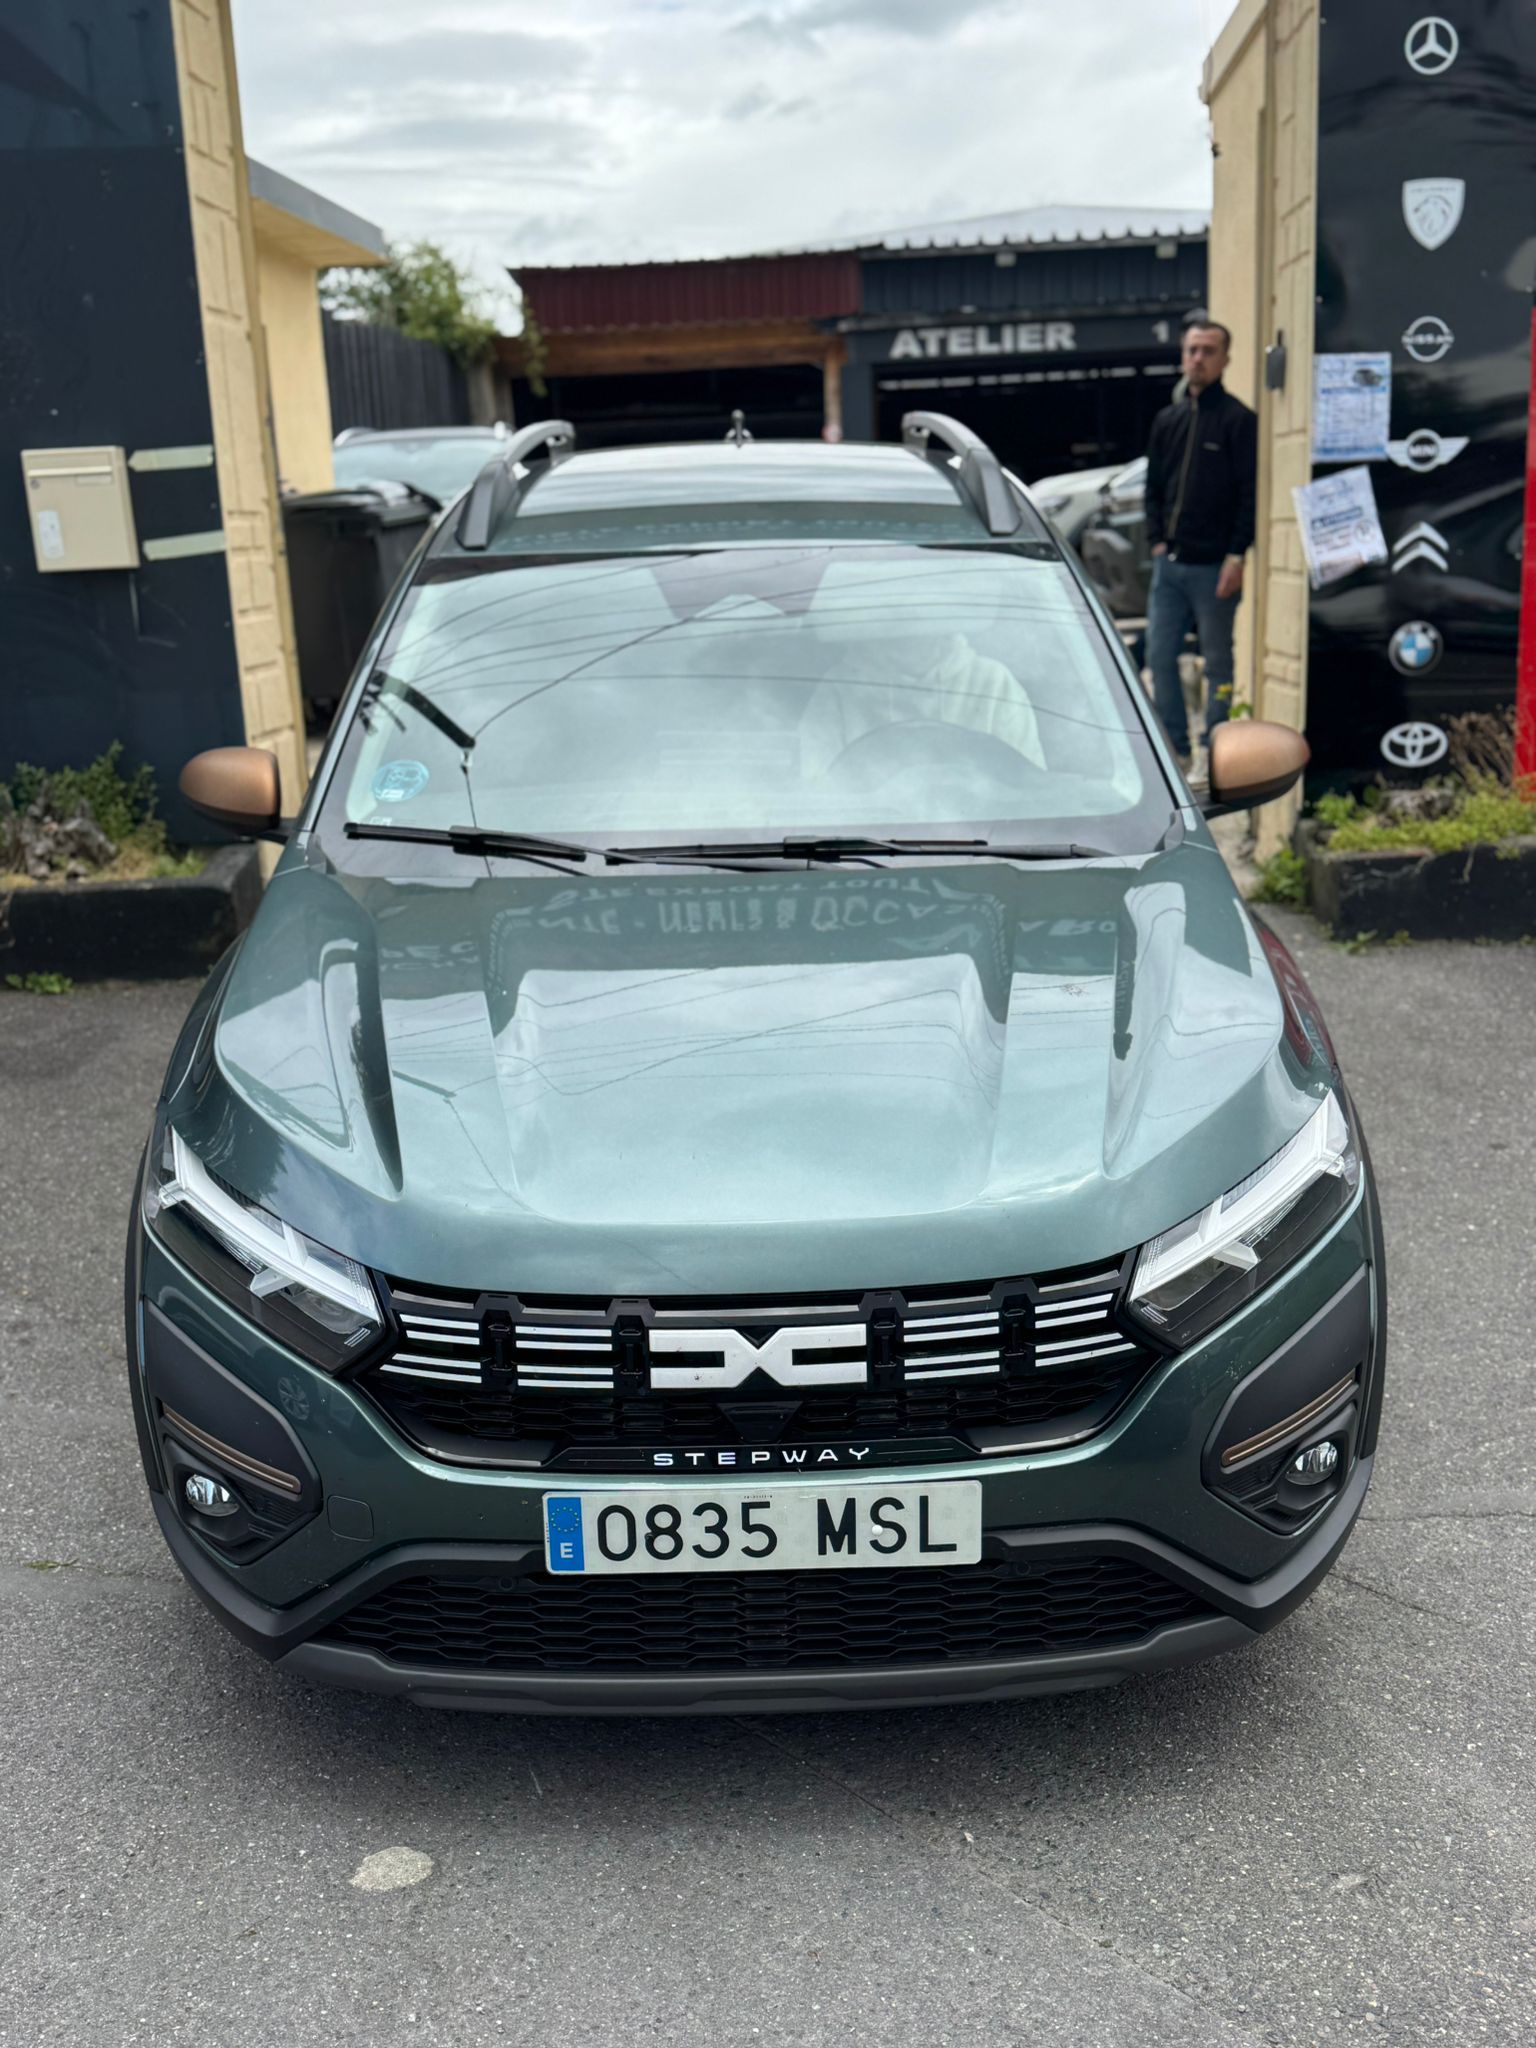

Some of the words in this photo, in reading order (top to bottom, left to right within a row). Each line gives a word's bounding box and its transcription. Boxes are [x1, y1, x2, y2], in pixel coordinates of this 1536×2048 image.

[889, 321, 1077, 359] ATELIER
[653, 1447, 870, 1466] STEPWAY
[560, 1542, 574, 1559] E
[597, 1501, 778, 1562] 0835
[817, 1495, 958, 1557] MSL
